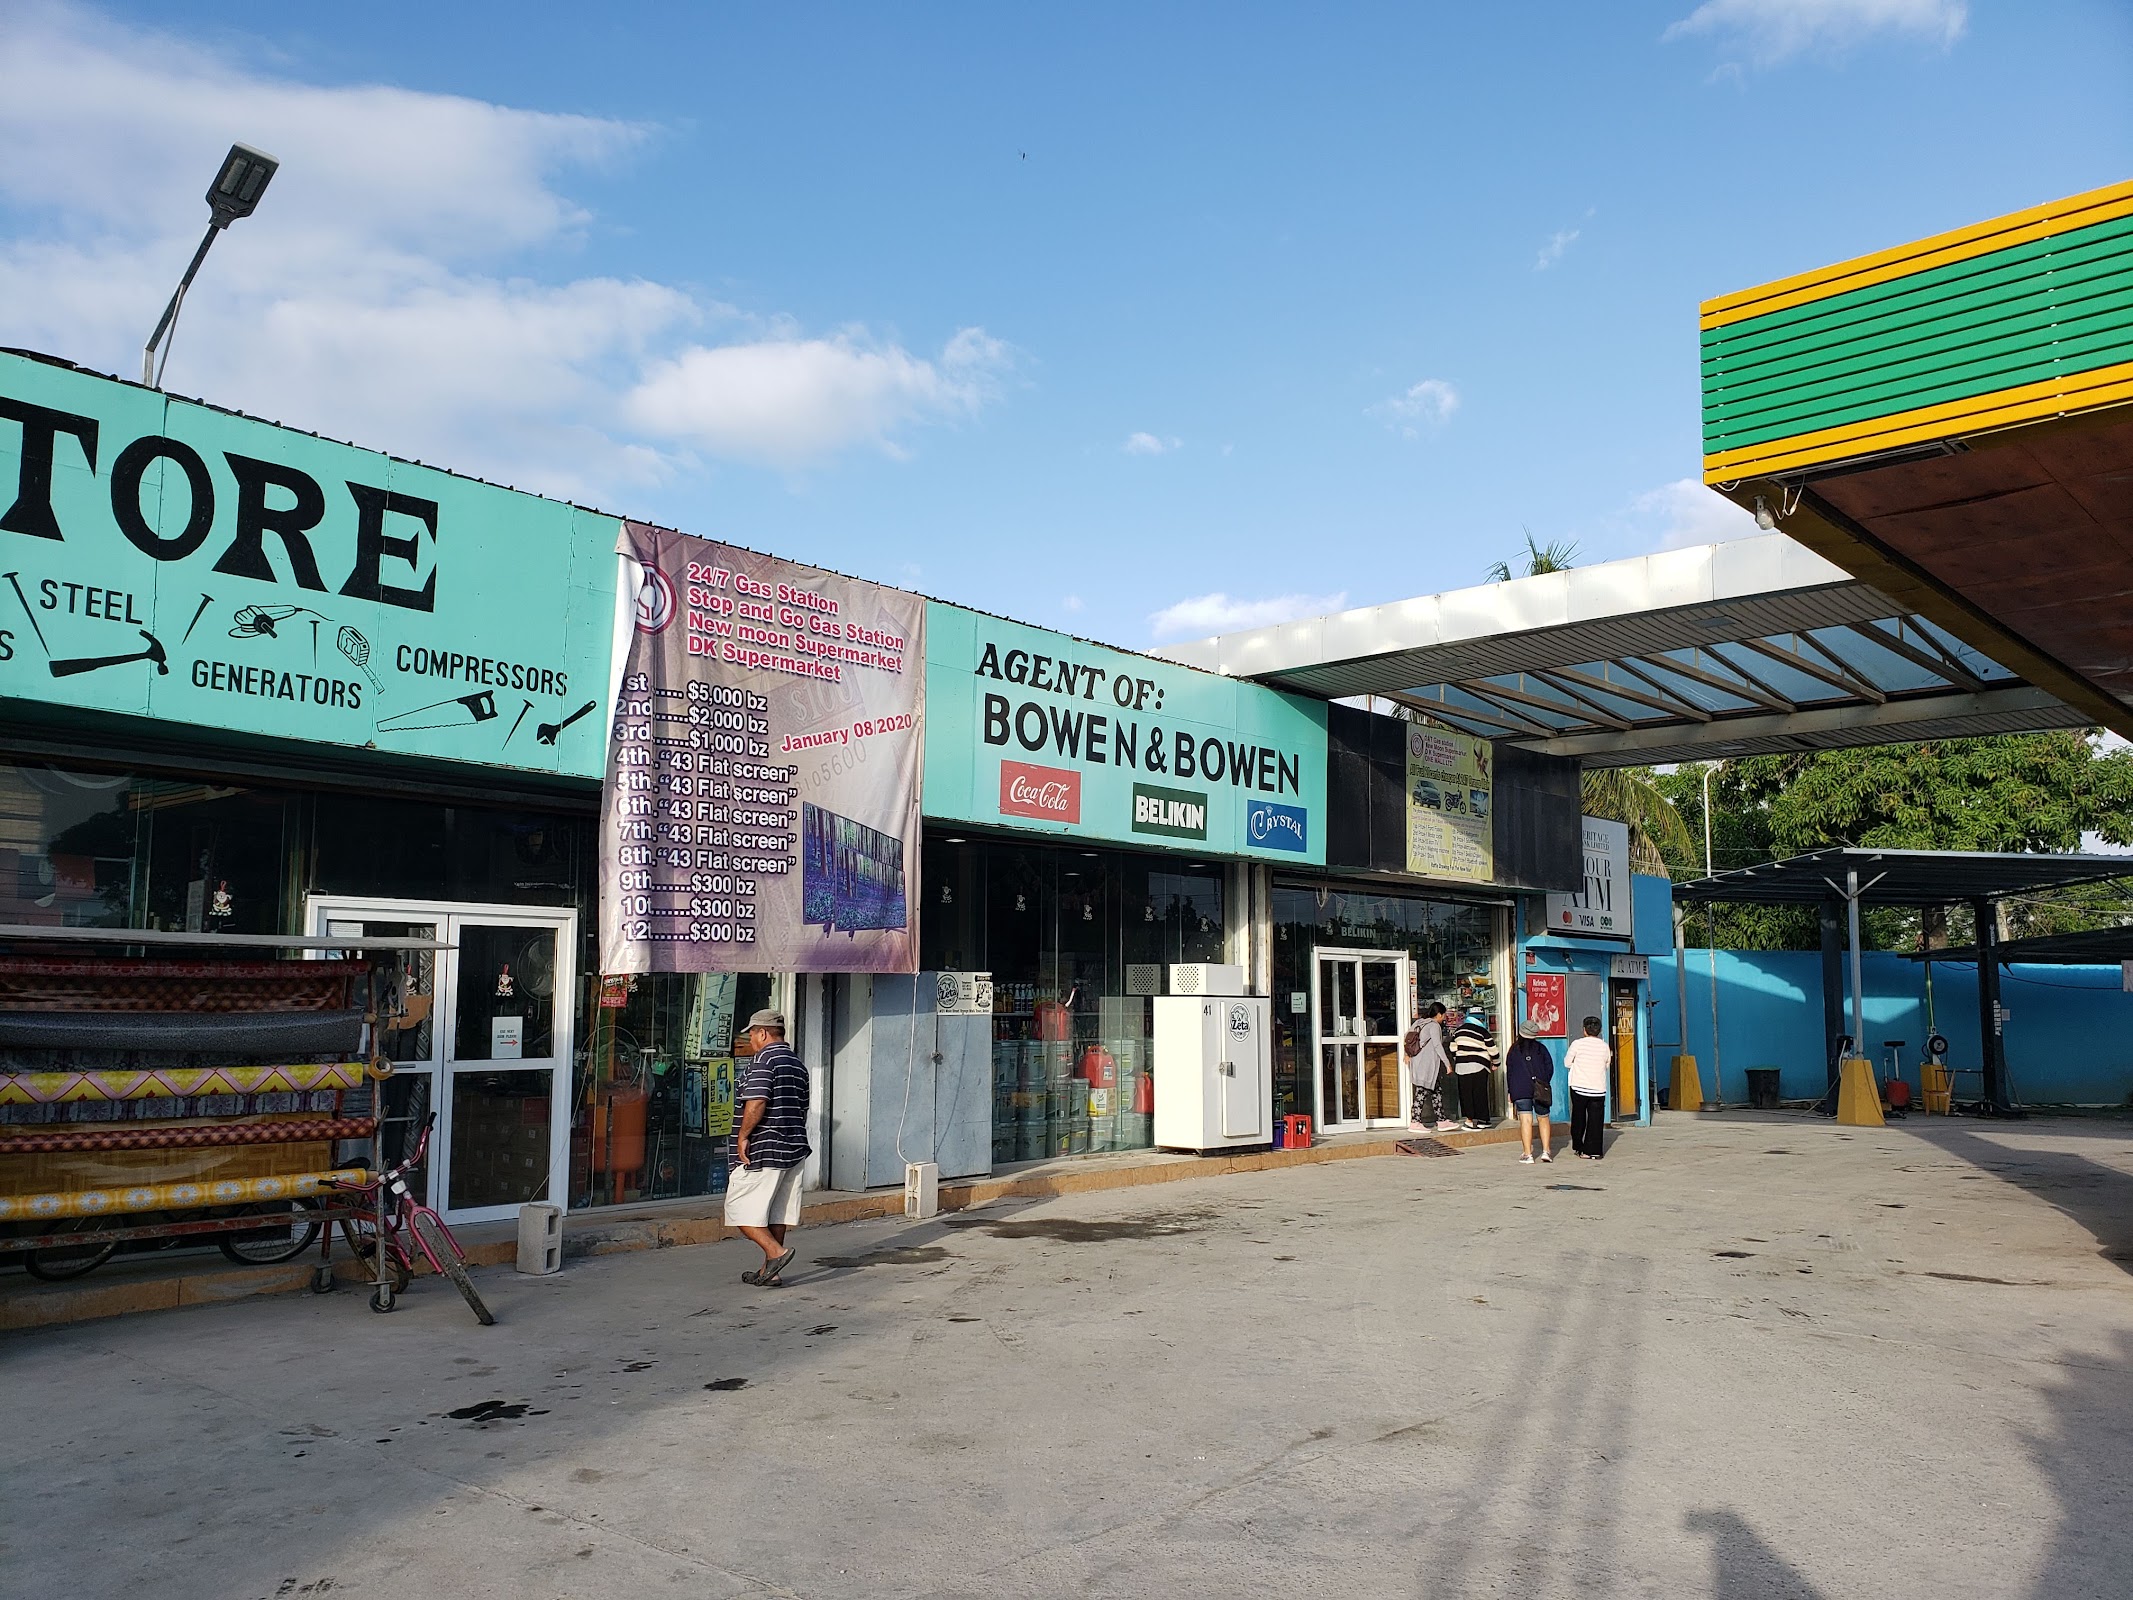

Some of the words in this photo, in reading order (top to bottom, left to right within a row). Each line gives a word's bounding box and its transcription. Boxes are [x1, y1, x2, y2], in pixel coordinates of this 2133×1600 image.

[40, 578, 143, 625] STEEL
[688, 563, 730, 588] 24/7
[735, 574, 772, 597] Gas
[777, 584, 839, 614] Station
[688, 587, 733, 615] Stop
[739, 600, 774, 621] and
[779, 607, 804, 627] Go
[809, 615, 841, 636] Gas
[846, 623, 904, 650] Station
[688, 611, 732, 636] New
[738, 624, 789, 648] moon
[795, 633, 902, 671] Supermarket
[396, 644, 569, 697] COMPRESSORS
[688, 635, 717, 657] DK
[723, 643, 841, 681] Supermarket
[191, 659, 362, 710] GENERATORS
[975, 643, 1106, 701] AGENT
[1113, 674, 1165, 711] OF:
[688, 681, 742, 706] $5,000
[747, 691, 767, 711] bz
[615, 697, 652, 716] 2nd
[747, 715, 768, 734] bz
[615, 722, 651, 741] 3rd
[748, 738, 768, 757] bz
[781, 728, 849, 754] January
[853, 713, 912, 738] 08/2020
[698, 755, 729, 776] Flat
[698, 779, 729, 799] Flat
[1009, 775, 1071, 812] Coca-Cola
[697, 802, 729, 823] Flat
[1135, 794, 1205, 831] BELIKIN
[1250, 808, 1304, 841] CRYSTAL
[697, 826, 729, 846] Flat
[696, 851, 728, 870] Flat
[1583, 856, 1611, 878] OUR
[736, 877, 755, 895] bz
[736, 900, 755, 918] bz
[1579, 914, 1595, 927] VISA
[735, 924, 755, 942] bz
[1341, 926, 1377, 938] BELIKIN
[1231, 1019, 1249, 1030] Zeta
